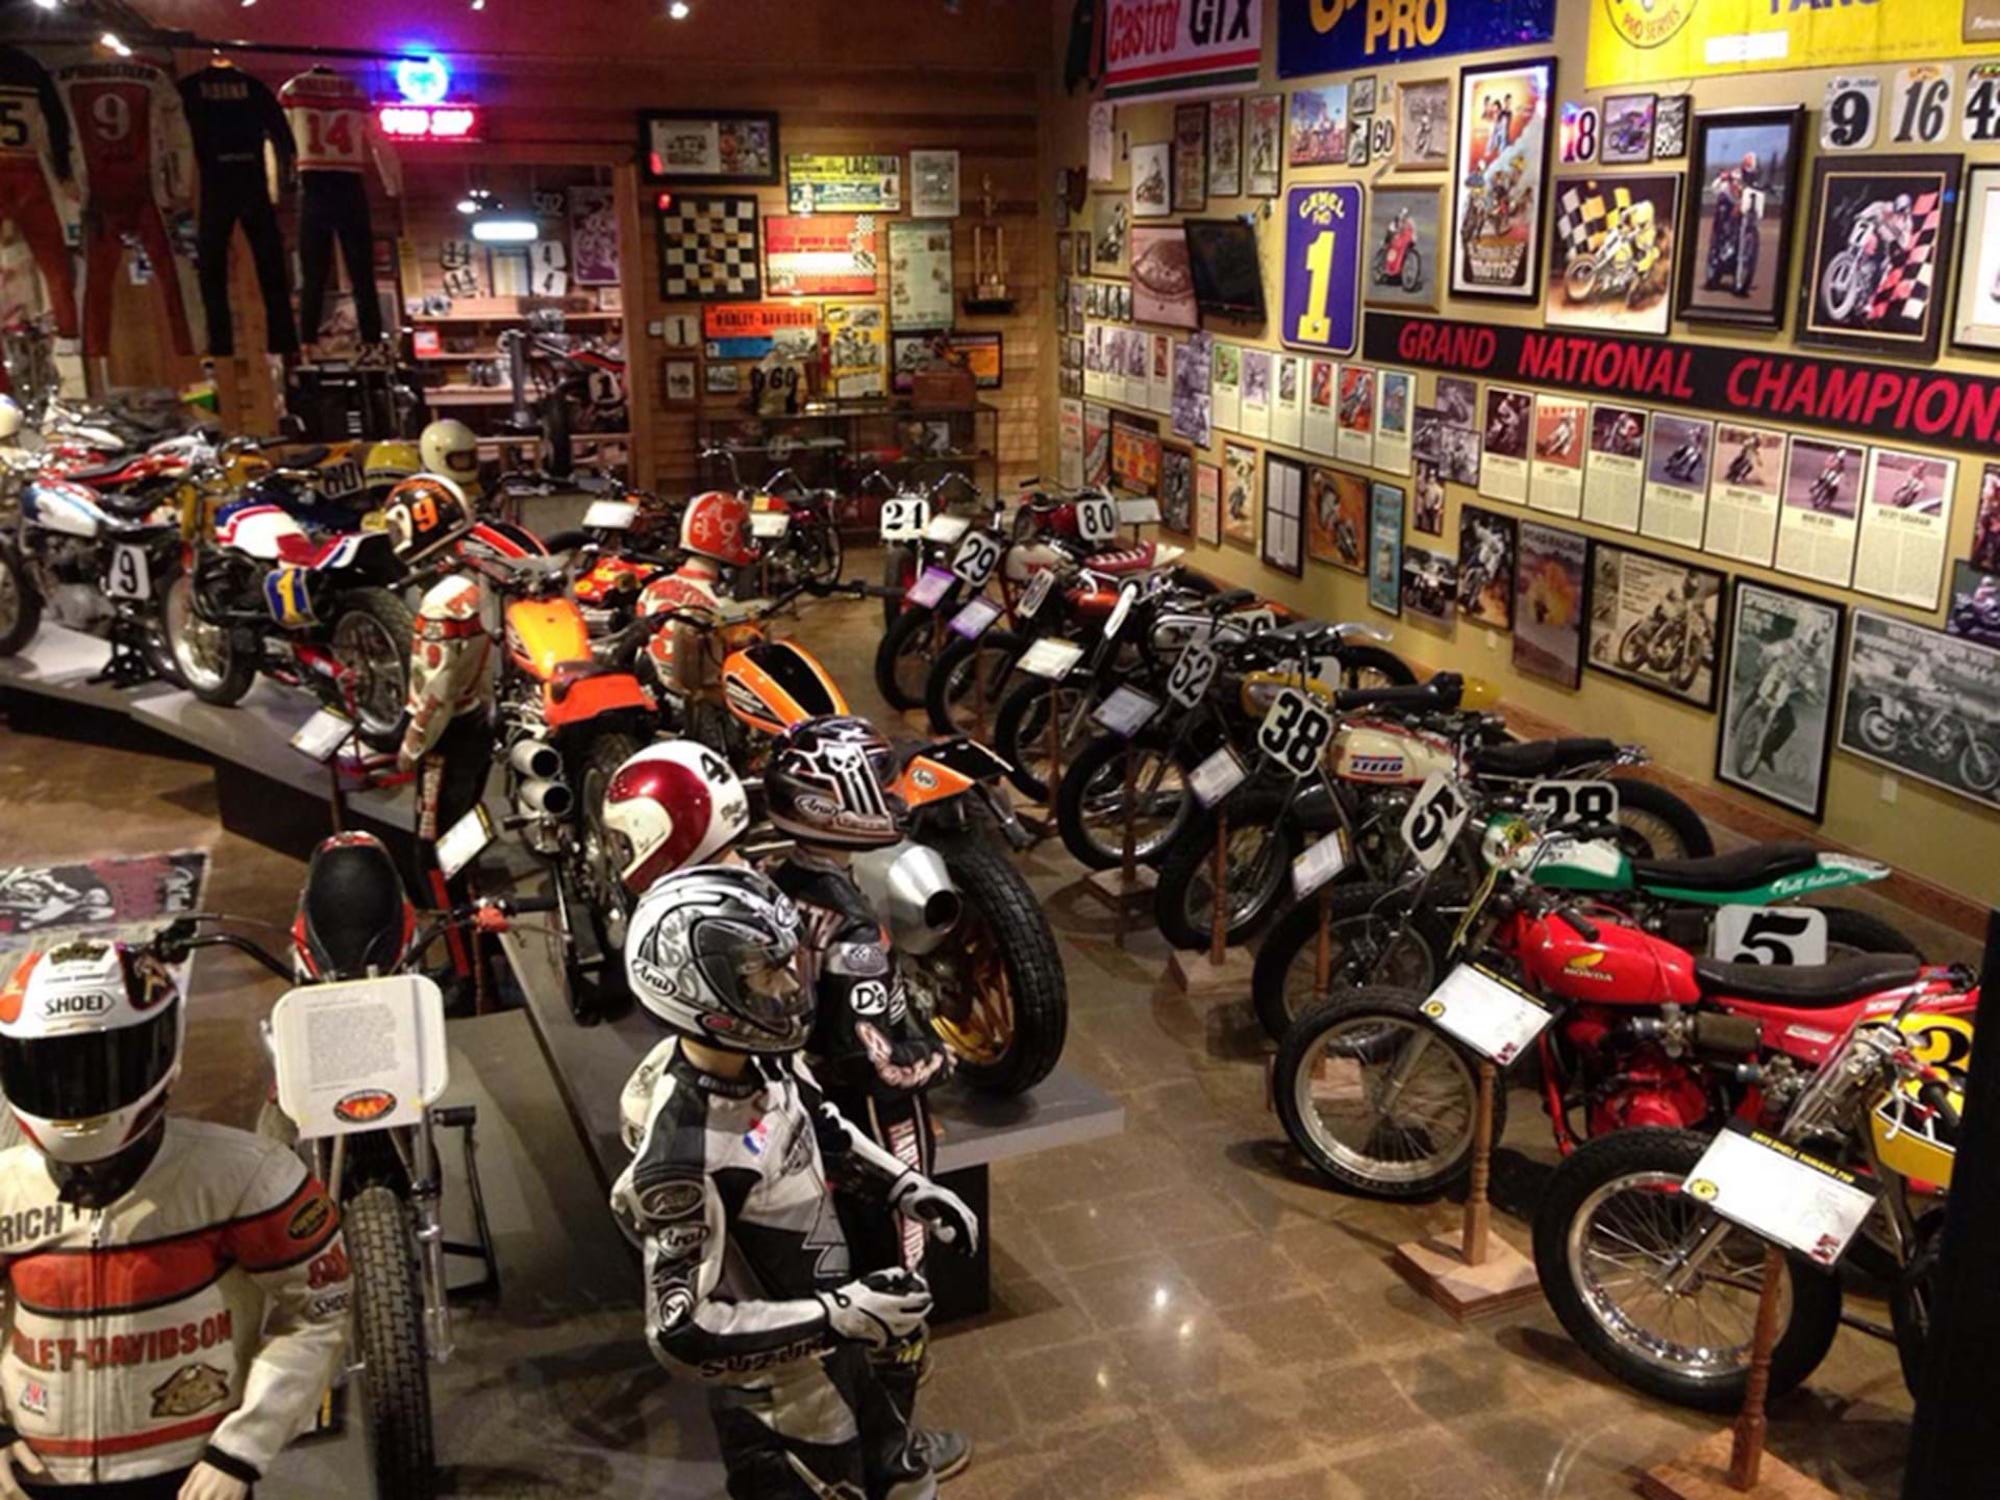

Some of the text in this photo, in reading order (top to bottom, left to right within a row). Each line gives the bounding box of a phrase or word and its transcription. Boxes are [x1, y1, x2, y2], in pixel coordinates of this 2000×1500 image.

[1109, 0, 1181, 64] Castrol
[1190, 0, 1250, 46] GTX
[1365, 0, 1447, 55] PRO
[94, 93, 130, 141] 9
[1829, 90, 1870, 146] 9
[1893, 79, 1949, 142] 16
[1966, 80, 2000, 142] 4
[306, 112, 353, 154] 14
[1373, 118, 1395, 151] 60
[1299, 190, 1346, 220] CAMEL
[1297, 230, 1336, 344] 1
[1399, 321, 2000, 442] GRAND NATIONAL CHAMPION
[885, 502, 924, 531] 21
[1083, 503, 1115, 535] 80
[118, 553, 137, 595] 9
[956, 538, 997, 582] 29
[276, 572, 298, 620] 1
[1171, 646, 1213, 702] 52
[1263, 690, 1329, 776] 38
[701, 752, 731, 785] 4
[1737, 912, 1810, 965] 5
[638, 964, 670, 992] Arai
[1563, 965, 1613, 982] HONDA
[45, 995, 104, 1016] SHOEI
[856, 983, 885, 1010] D's
[0, 1205, 64, 1246] RICH
